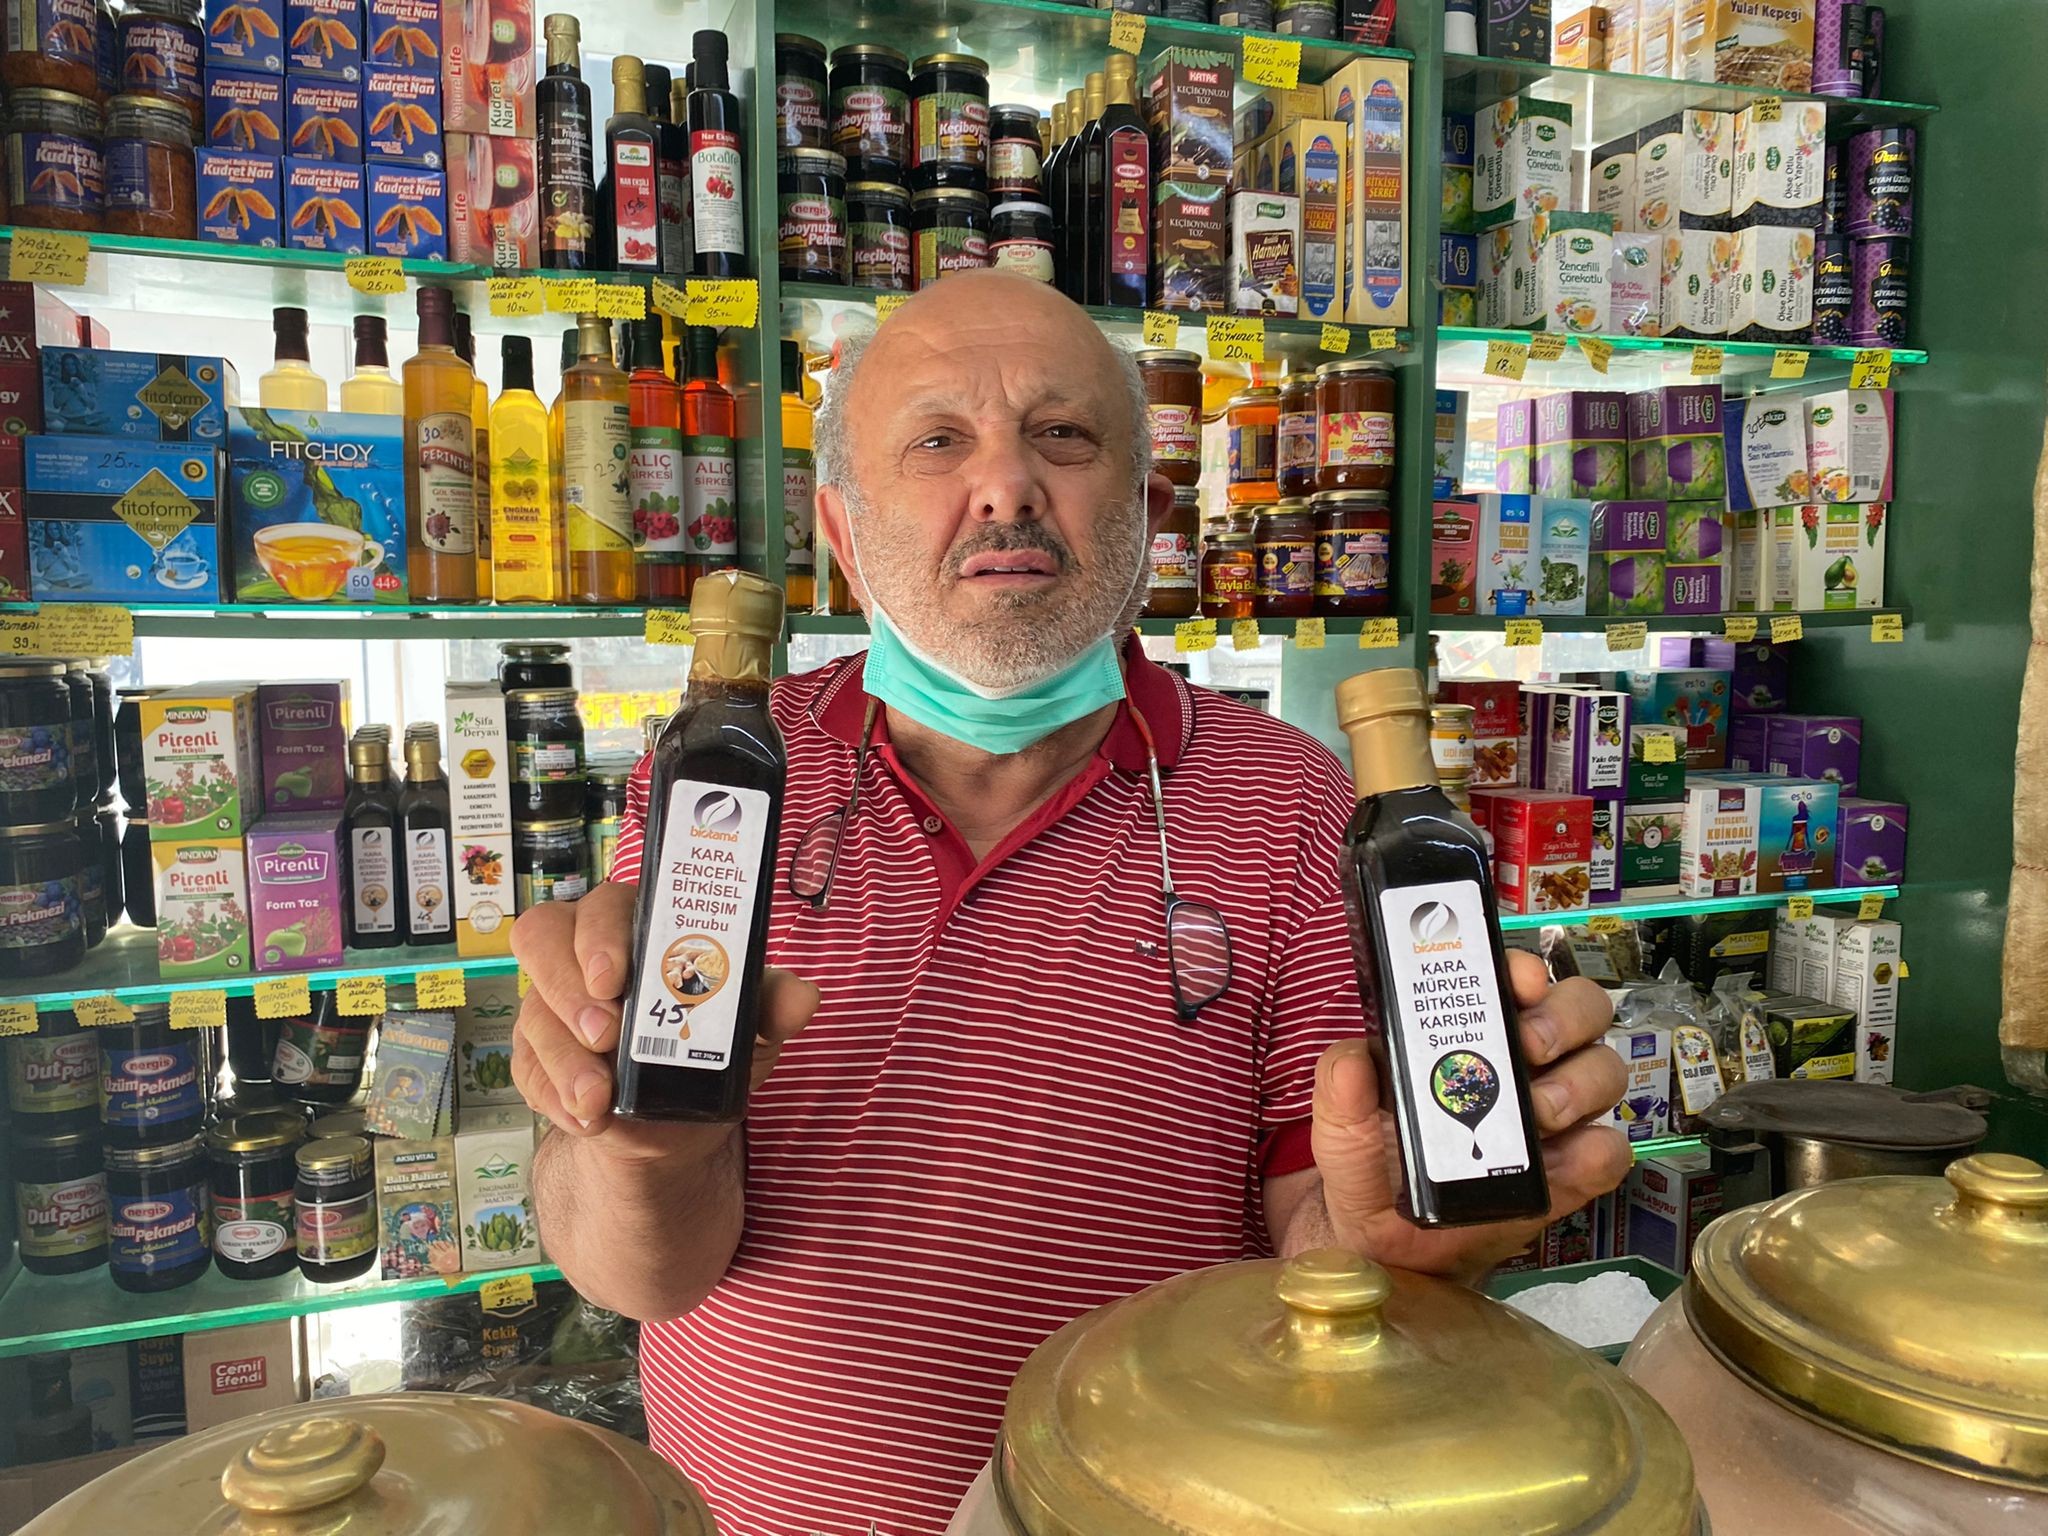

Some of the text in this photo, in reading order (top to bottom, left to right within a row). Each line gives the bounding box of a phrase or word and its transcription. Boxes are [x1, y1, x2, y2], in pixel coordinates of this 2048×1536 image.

[373, 4, 410, 17] Kudret
[211, 85, 251, 98] Kudret
[368, 79, 408, 93] Kudret
[780, 86, 813, 98] nergis
[1177, 85, 1230, 98] KEÇİBOYNUZU
[292, 93, 332, 106] Kudret
[491, 80, 501, 127] Kudret
[849, 96, 884, 107] nergis
[1196, 96, 1211, 105] TOZ
[1526, 147, 1562, 161] Zencefilli
[203, 164, 274, 180] Kudret Narı
[1527, 158, 1564, 173] Çörekotlu
[291, 175, 359, 190] Kudret Narı
[375, 181, 440, 197] Kudret Narı
[1366, 176, 1400, 188] BİTKİSEL
[794, 203, 829, 216] nergis
[1169, 218, 1221, 231] KEÇİBOYNUZU
[1189, 229, 1204, 237] TOZ
[1559, 261, 1601, 272] Zencefilli
[1559, 272, 1603, 285] Çörekotlu
[144, 389, 202, 406] fitoform
[1157, 412, 1186, 422] nergis
[270, 441, 374, 461] FITCHOY
[631, 454, 671, 470] ALIÇ
[696, 462, 732, 476] ALIÇ
[120, 500, 192, 517] fitoform
[503, 506, 540, 514] ENGİNAR
[135, 521, 180, 532] fitoform
[352, 575, 370, 588] 60
[1214, 579, 1243, 592] Yayla
[274, 706, 327, 720] Pirenli
[474, 716, 493, 728] Şifa
[158, 732, 219, 748] Pirenli
[463, 728, 500, 739] Deryası
[276, 744, 325, 753] Form Toz
[690, 825, 739, 843] biotama
[1706, 825, 1753, 841] KUİNOALI
[691, 847, 735, 865] KARA
[264, 857, 321, 874] Pirenli
[671, 861, 747, 884] ZENCEFİL
[170, 869, 229, 887] Pirenli
[672, 878, 743, 900] BİTKİSEL
[265, 898, 320, 910] Form Toz
[671, 896, 738, 917] KARIŞIM
[10, 901, 65, 925] Pekmezi
[675, 914, 729, 932] Şurubu
[1413, 936, 1463, 954] biotama
[1730, 934, 1765, 945] MATCHA
[1421, 960, 1467, 976] KARA
[1413, 975, 1481, 995] MÜRVER
[1414, 992, 1487, 1013] BİTKİSEL
[650, 999, 696, 1027] 45
[1420, 1011, 1487, 1031] KARIŞIM
[1428, 1030, 1484, 1050] Şurubu
[126, 1057, 171, 1071] nergis
[1639, 1057, 1668, 1072] KELEBEK
[1811, 1057, 1850, 1067] MATCHA
[27, 1063, 59, 1081] Dut
[1683, 1067, 1698, 1079] GOJI
[104, 1076, 139, 1093] Üzüm
[395, 1153, 436, 1163] AKSU VITAL
[57, 1186, 97, 1201] nergis
[28, 1208, 58, 1226] Dut
[126, 1204, 168, 1218] nergis
[482, 1326, 519, 1342] Kekik
[139, 1352, 174, 1367] Suyu
[216, 1360, 261, 1376] Cemil
[216, 1373, 261, 1388] Efendi
